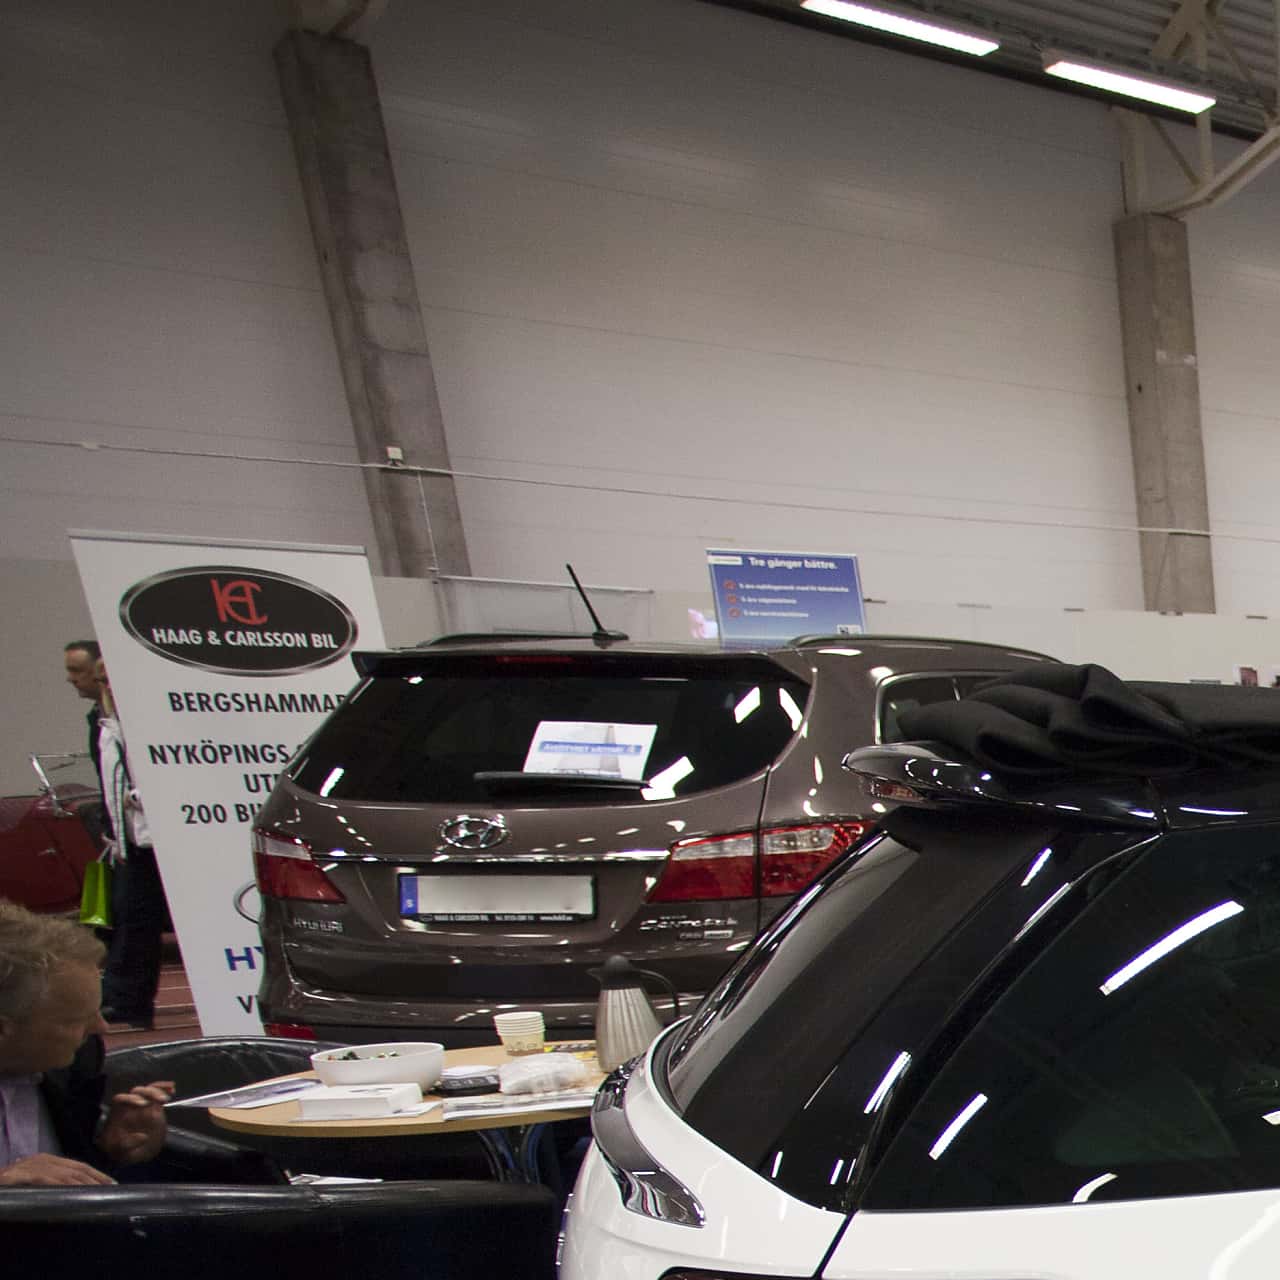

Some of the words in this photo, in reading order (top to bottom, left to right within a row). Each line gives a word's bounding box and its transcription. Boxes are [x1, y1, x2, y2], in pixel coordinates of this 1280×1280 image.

[748, 557, 765, 567] Tre
[151, 628, 202, 646] HAAG
[207, 630, 221, 646] &
[225, 630, 308, 649] CARLSSON
[311, 633, 338, 649] BIL
[148, 739, 290, 765] NYKÖPINGS
[180, 804, 227, 825] 200
[236, 803, 263, 824] BI
